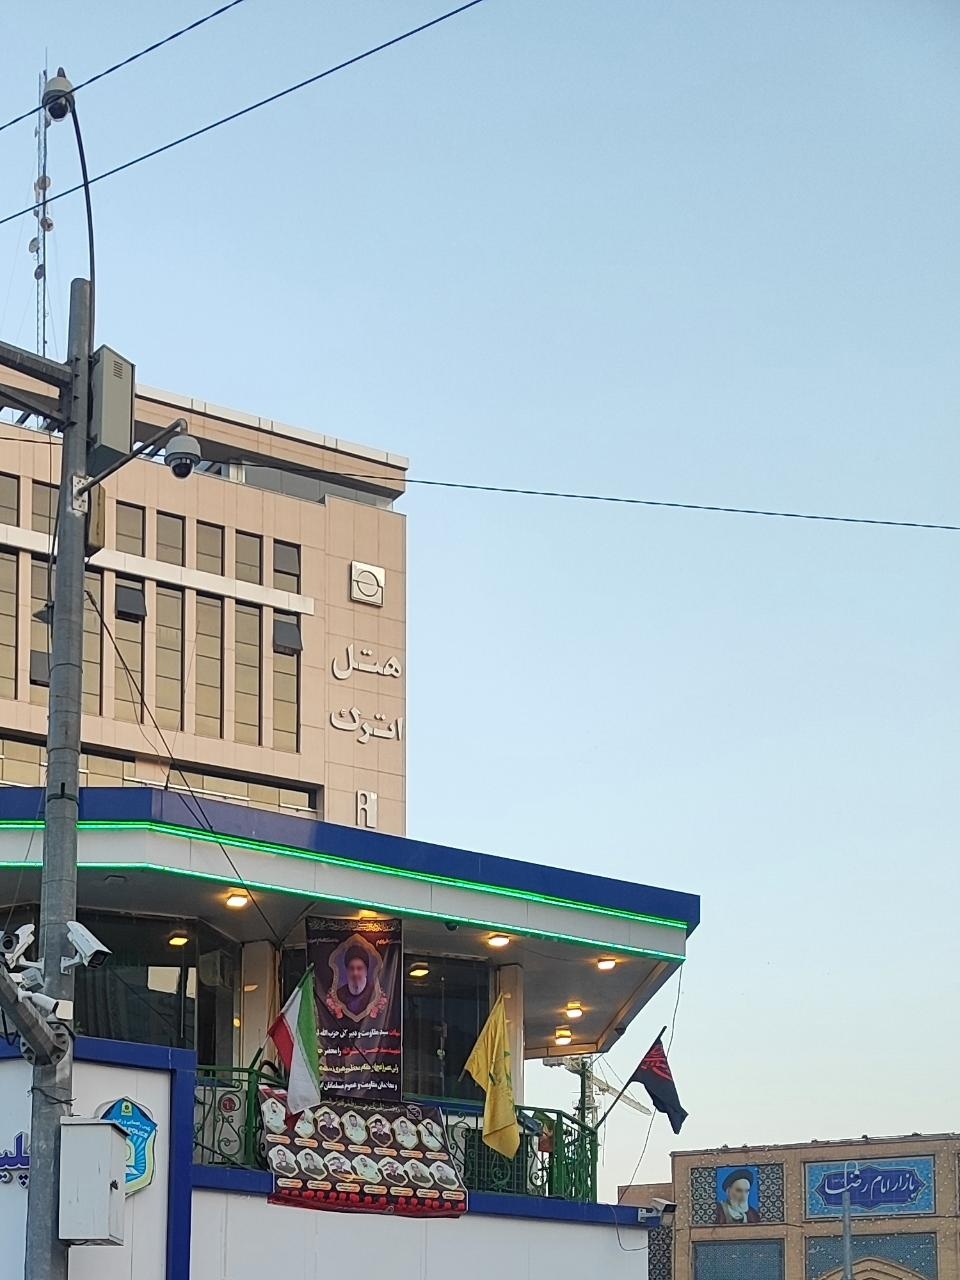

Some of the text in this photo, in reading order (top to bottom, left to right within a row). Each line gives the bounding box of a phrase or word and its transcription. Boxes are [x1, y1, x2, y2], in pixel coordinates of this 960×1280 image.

[331, 643, 404, 681] هتل
[824, 1174, 869, 1195] رضا
[870, 1175, 890, 1200] امام
